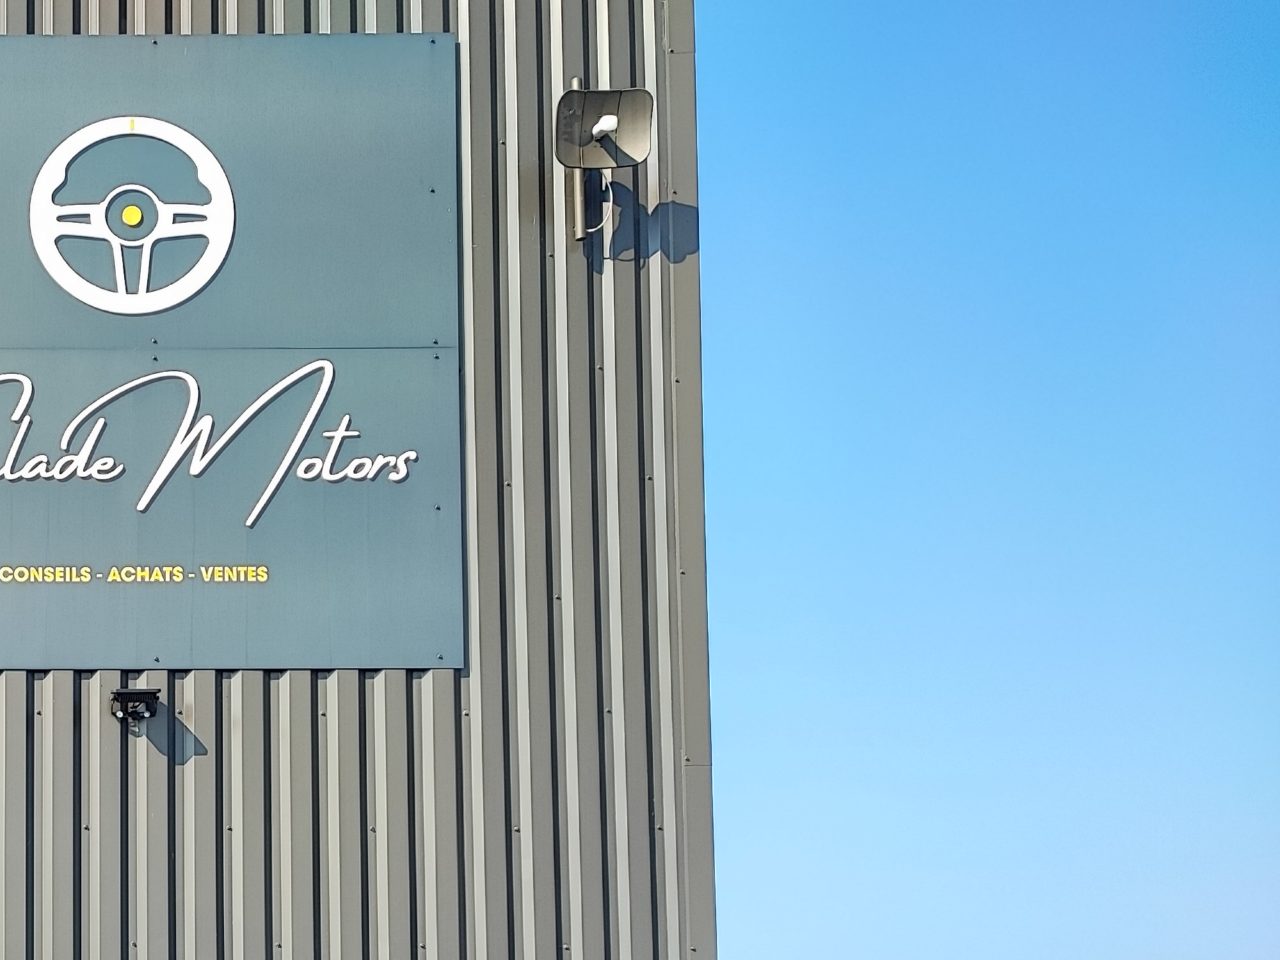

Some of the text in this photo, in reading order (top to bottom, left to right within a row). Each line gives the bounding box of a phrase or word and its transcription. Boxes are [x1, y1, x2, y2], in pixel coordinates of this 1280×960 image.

[61, 360, 418, 527] Motors
[107, 566, 184, 582] ACHATS
[200, 566, 268, 582] VENTES
